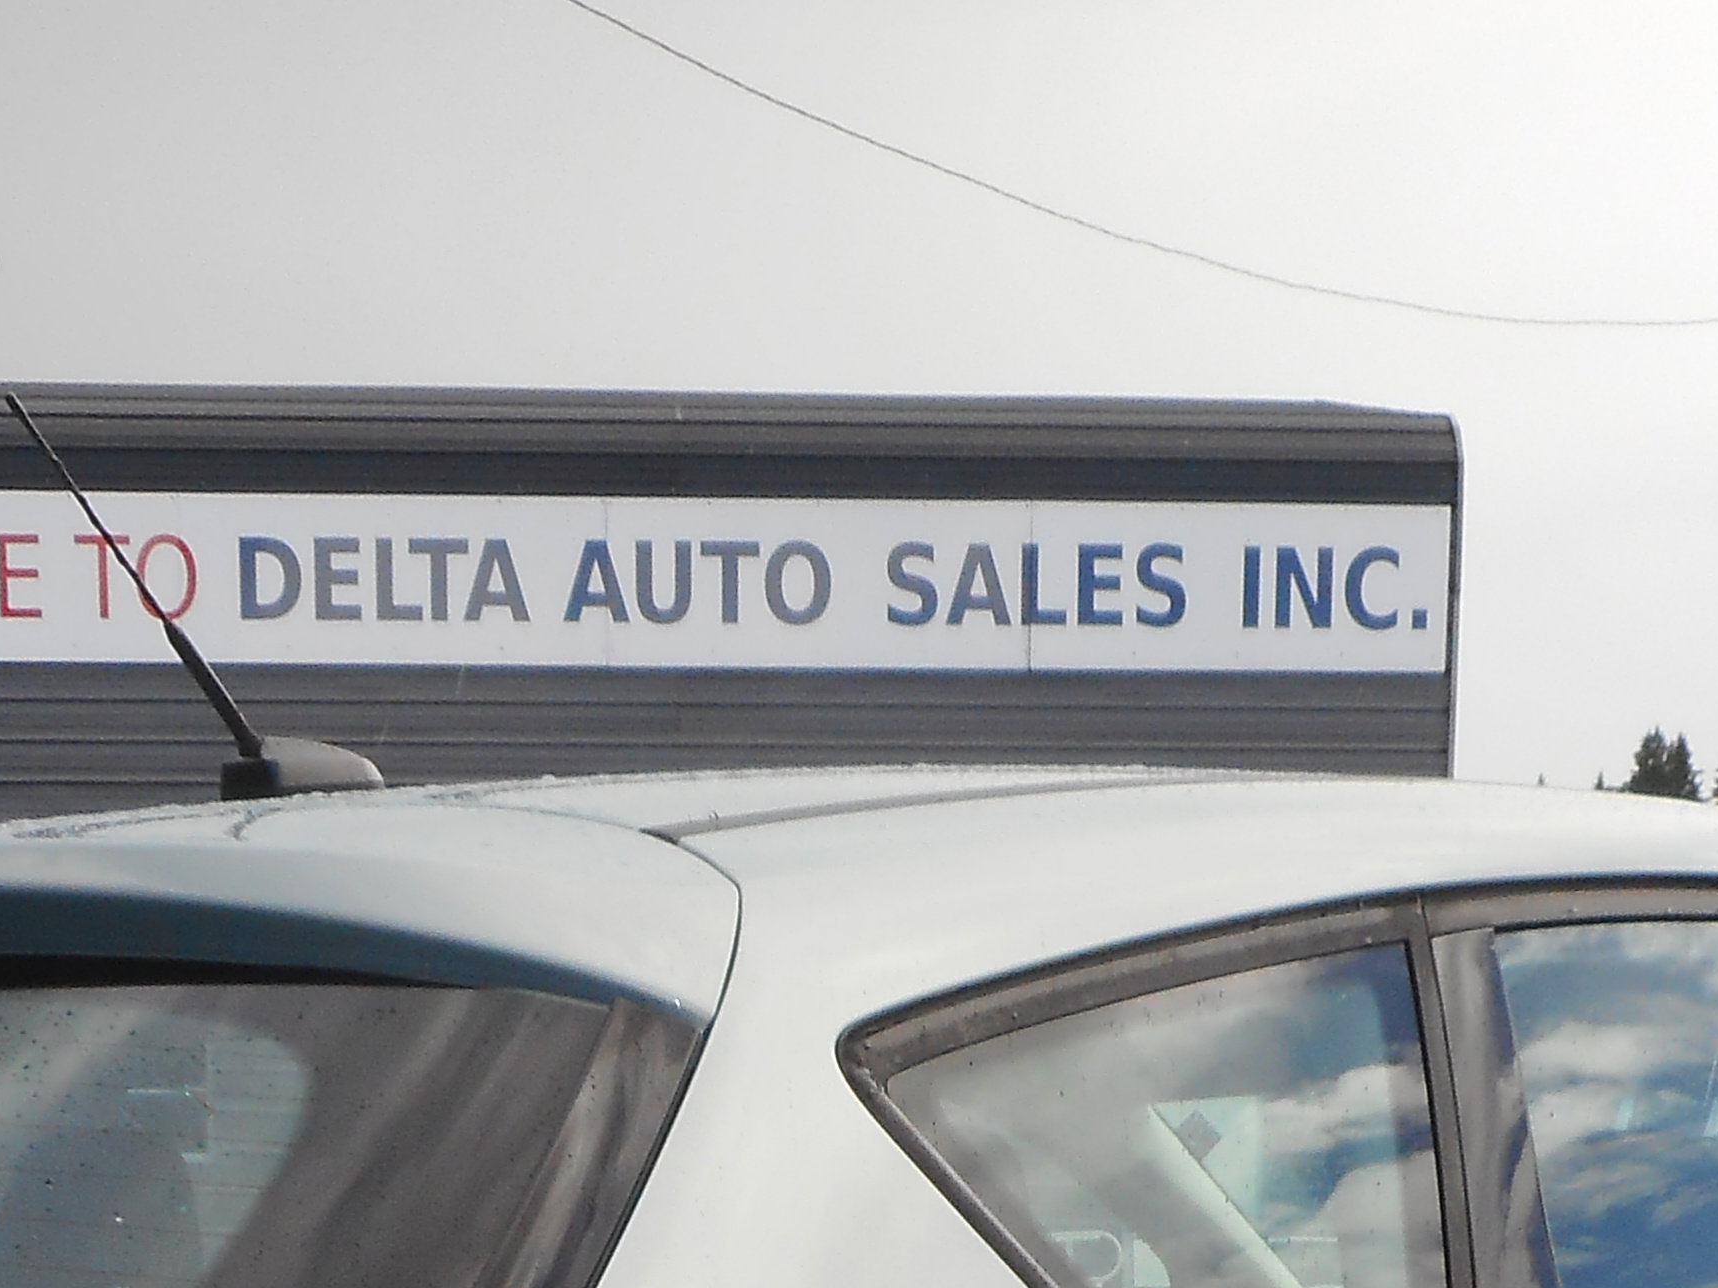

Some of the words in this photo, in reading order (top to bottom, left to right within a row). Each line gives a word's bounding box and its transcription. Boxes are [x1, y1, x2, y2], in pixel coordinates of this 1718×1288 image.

[73, 531, 199, 622] TO
[237, 534, 531, 625] DELTA
[562, 537, 833, 627] AUTO
[883, 541, 1188, 629] SALES
[1240, 544, 1430, 631] INC.
